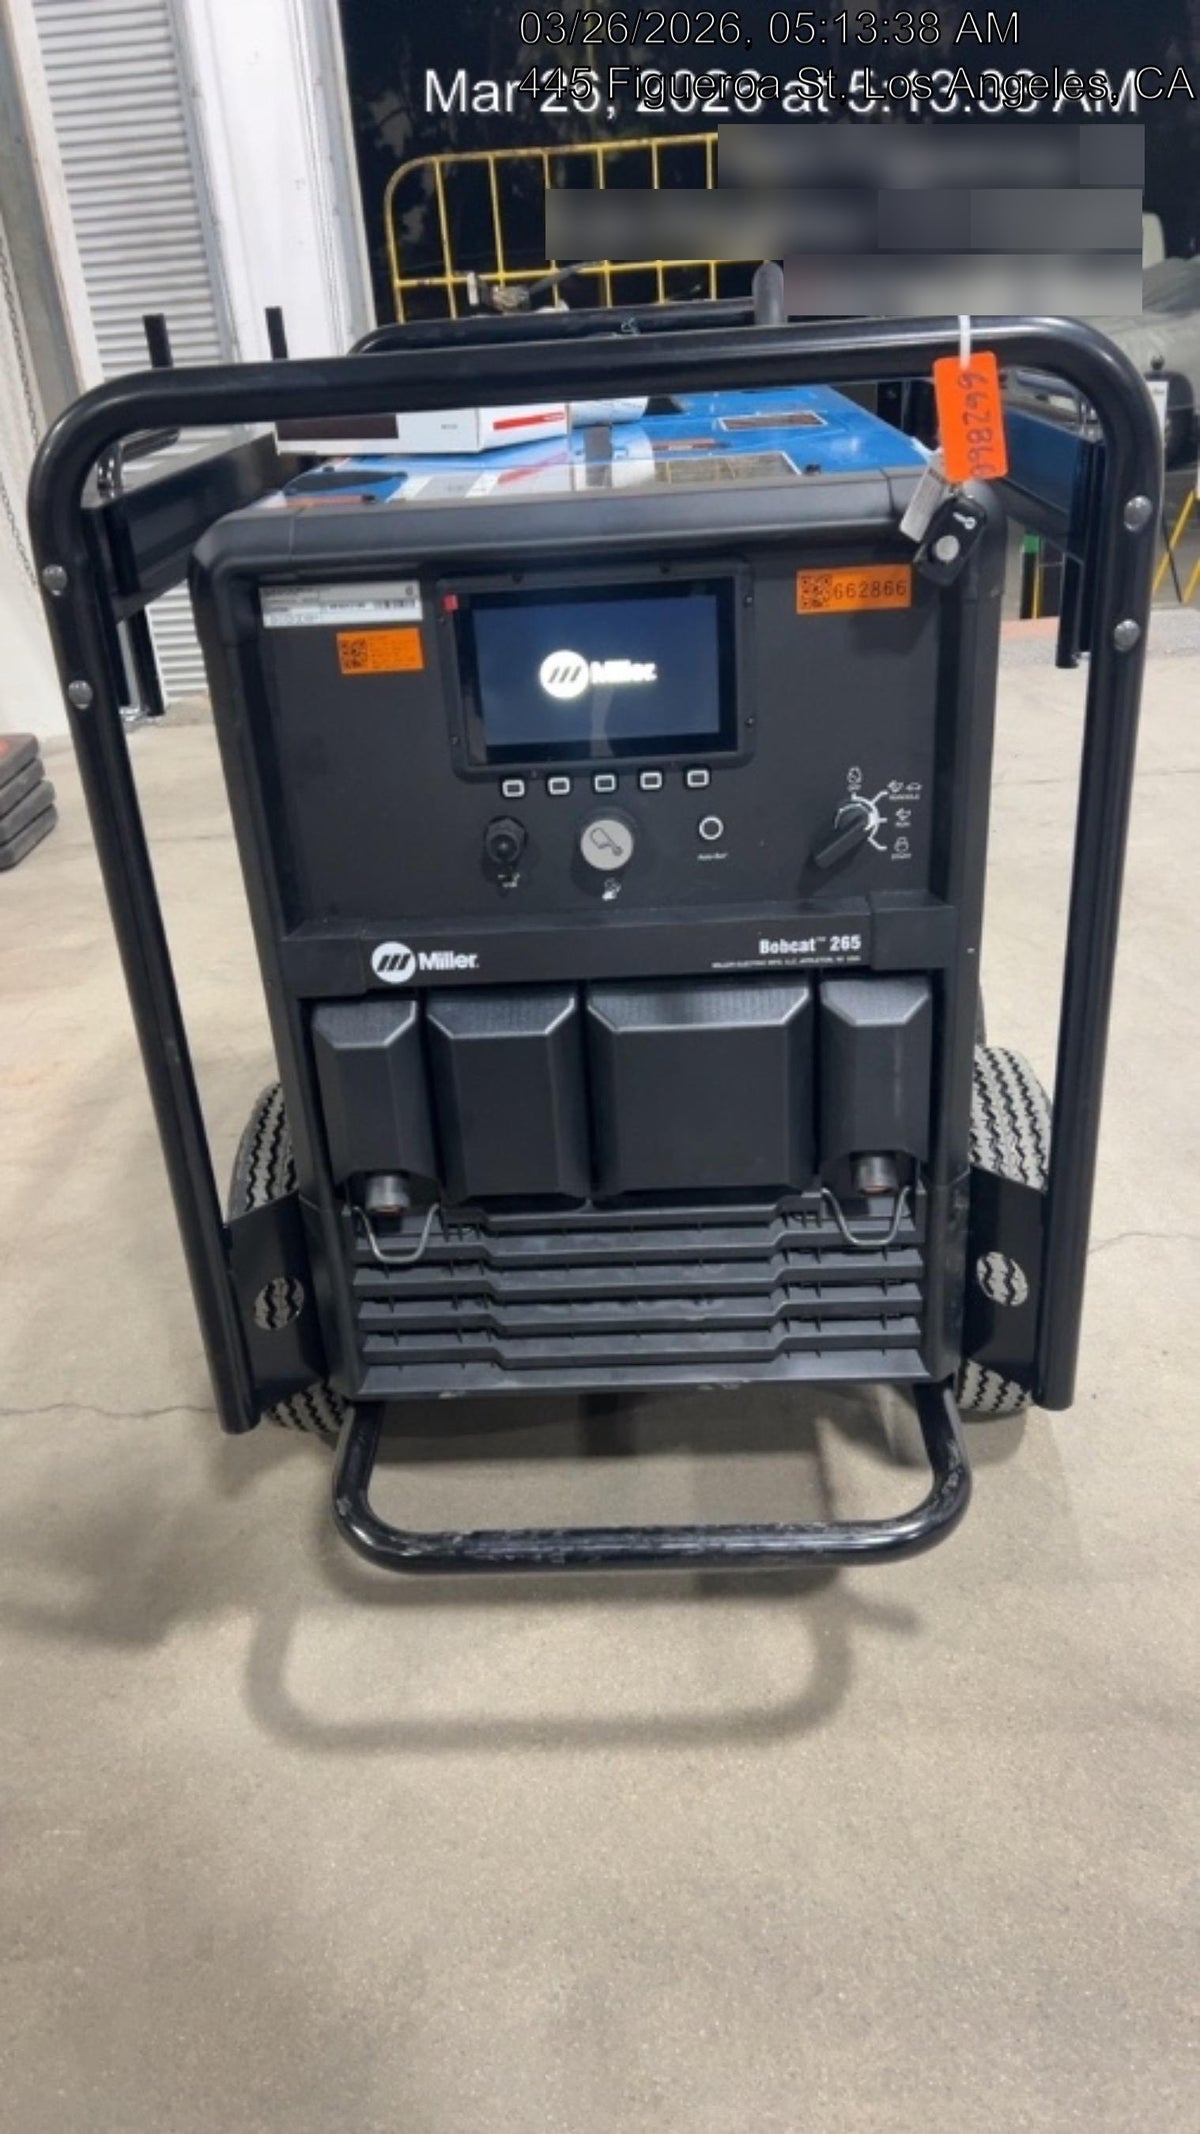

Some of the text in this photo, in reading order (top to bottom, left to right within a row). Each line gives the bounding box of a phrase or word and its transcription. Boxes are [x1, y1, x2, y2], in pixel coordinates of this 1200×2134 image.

[833, 580, 907, 600] 662866
[830, 934, 861, 951] 265
[418, 950, 480, 970] Miller
